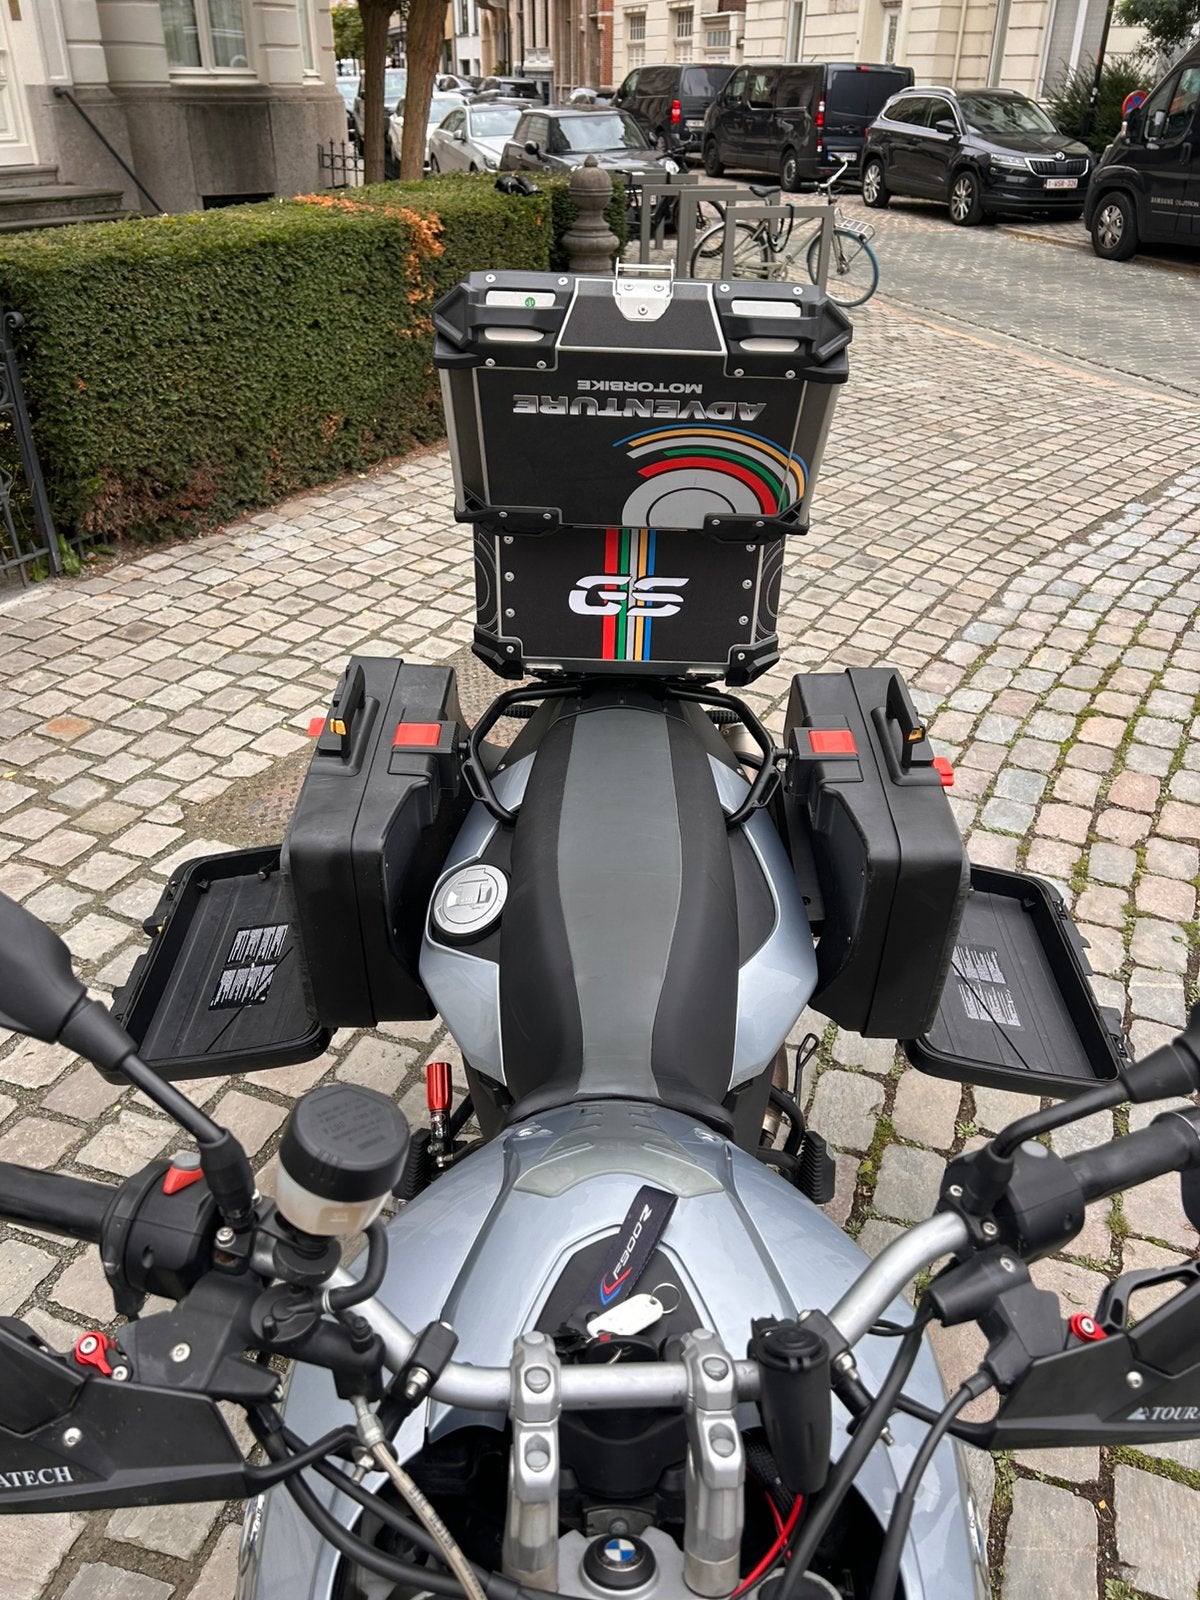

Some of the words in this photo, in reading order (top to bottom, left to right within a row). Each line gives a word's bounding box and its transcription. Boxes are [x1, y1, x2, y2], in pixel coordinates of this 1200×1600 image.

[577, 379, 703, 394] MOTORBIKE
[513, 394, 767, 421] ADVENTURE
[568, 575, 690, 617] GS
[1151, 1406, 1200, 1420] TOUR
